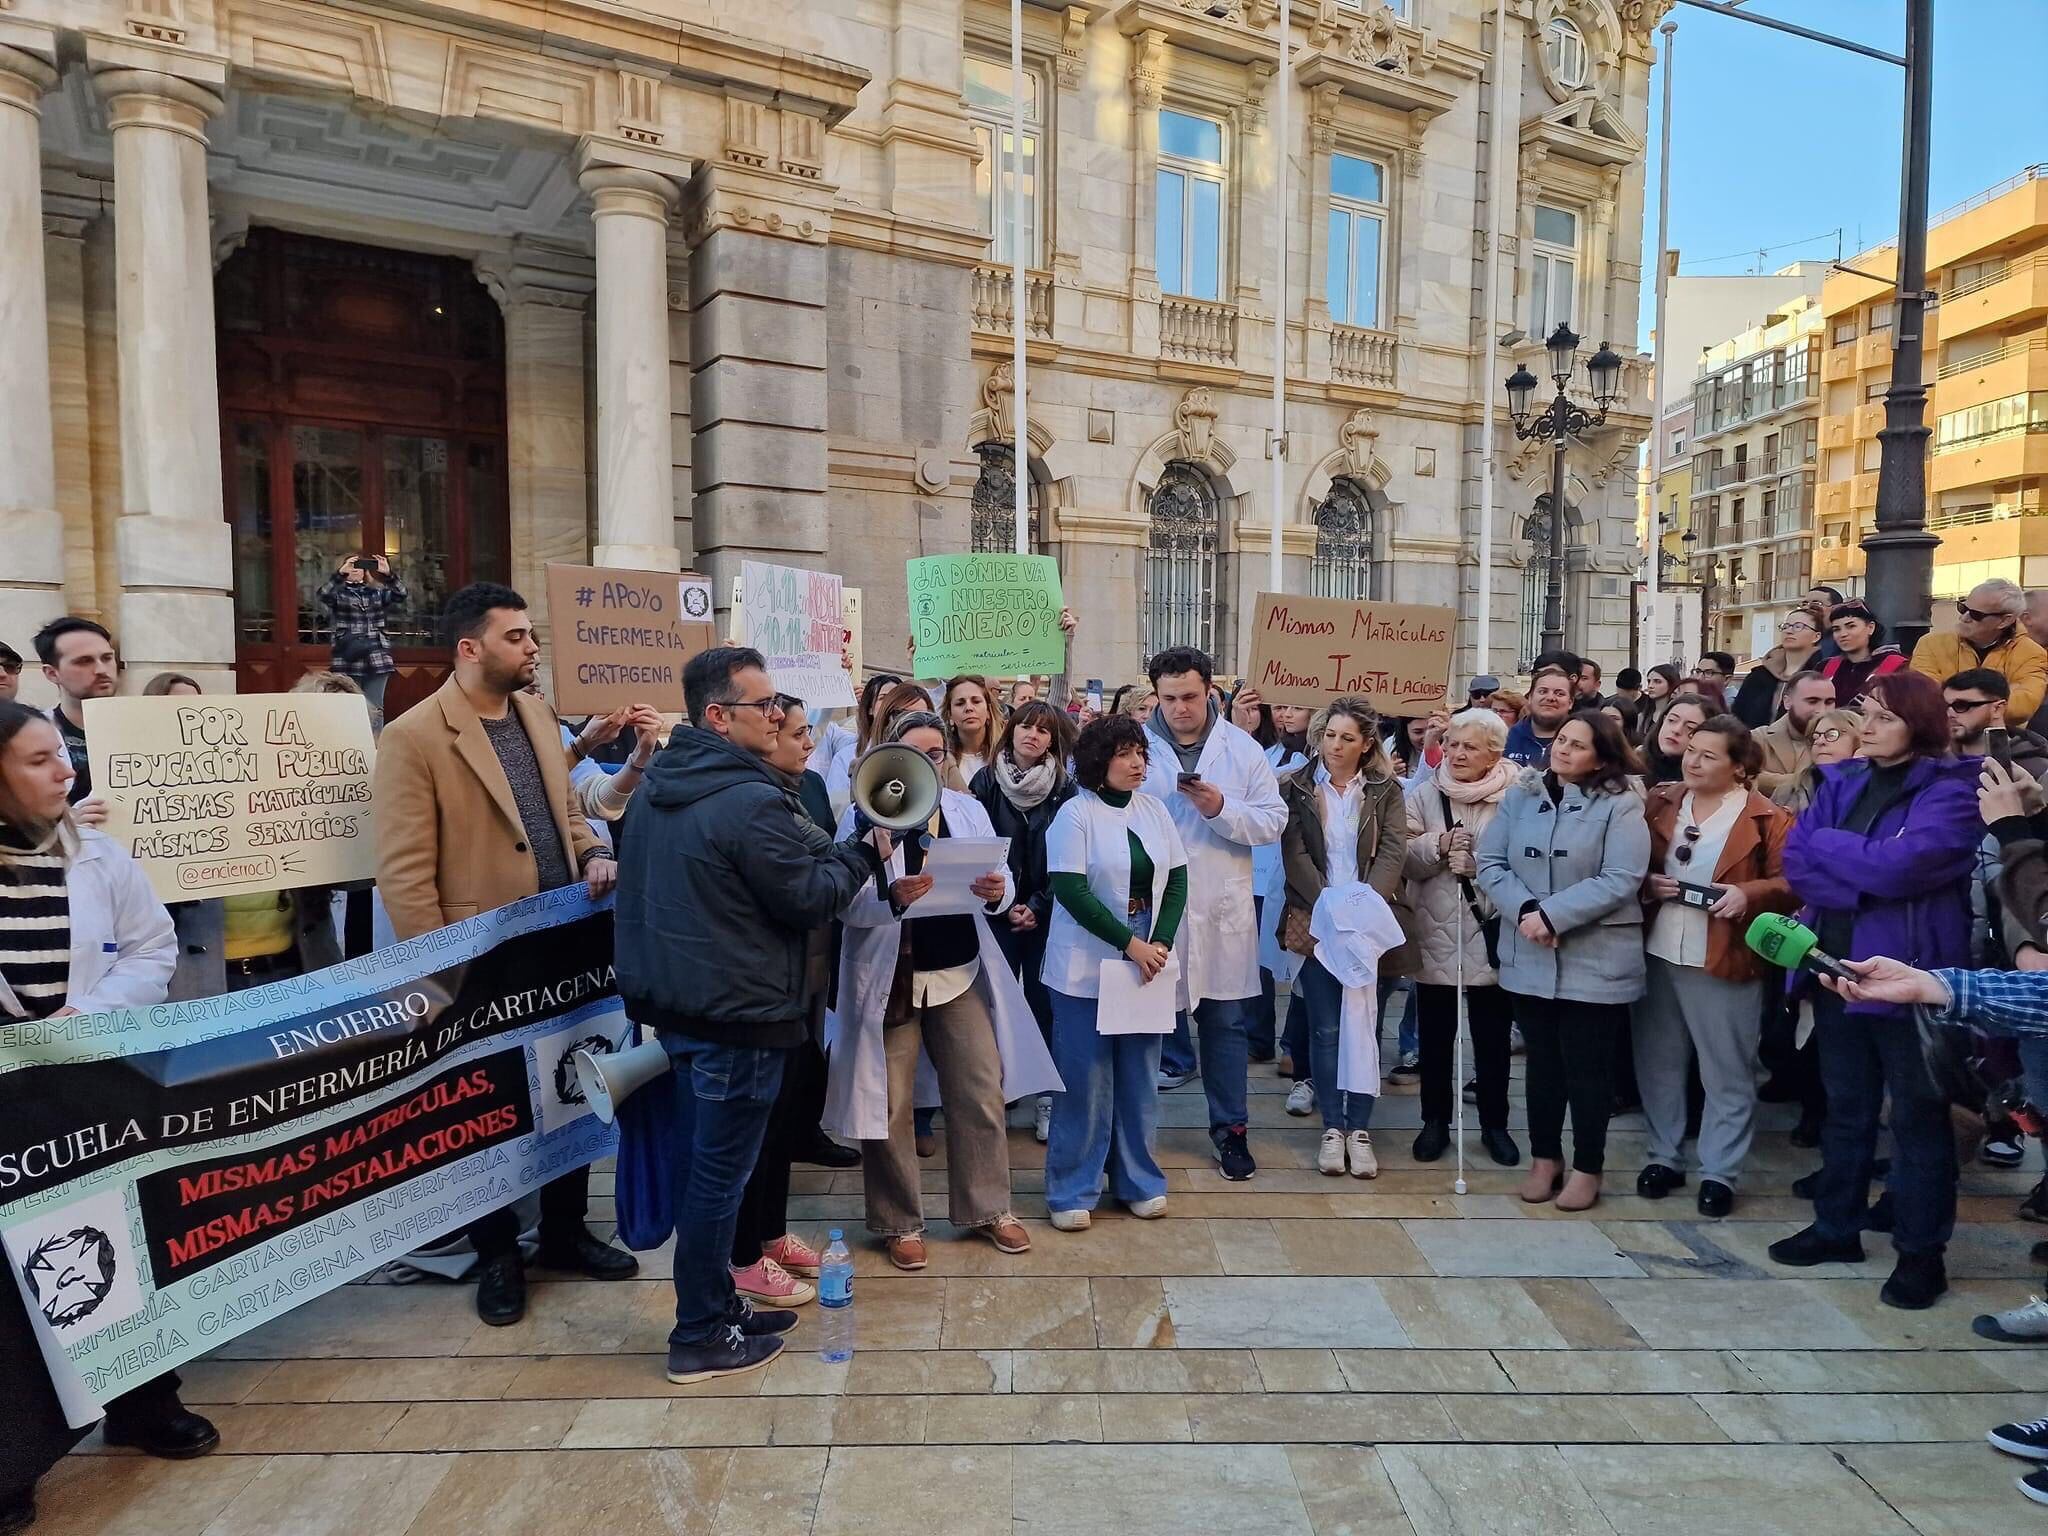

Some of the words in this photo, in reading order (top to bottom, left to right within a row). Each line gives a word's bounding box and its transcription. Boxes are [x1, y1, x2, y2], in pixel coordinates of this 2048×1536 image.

[914, 562, 947, 591] ¿A
[951, 557, 1018, 586] DÓNDE
[1023, 562, 1047, 582] VA
[602, 582, 663, 613] APOYO
[952, 588, 1049, 612] NUESTRO
[576, 620, 685, 650] ENFERMERÍA
[919, 608, 1056, 648] DINERO?
[578, 663, 673, 685] CARTAGENA
[177, 706, 248, 746] POR
[265, 709, 306, 746] LA
[109, 746, 259, 788] EDUCACIÓN
[278, 743, 369, 779] PÚBLICA
[248, 780, 372, 814] MATRÍCULAS
[132, 826, 230, 859] MISMOS
[182, 857, 273, 884] @encierroct
[149, 974, 324, 1028] CARTAGENA
[495, 882, 590, 926] CARTAGE
[267, 991, 431, 1059] ENCIERRO
[160, 1106, 215, 1139] DE
[228, 1037, 429, 1127] ENFERMERÍA
[435, 1016, 465, 1052] DE
[469, 964, 617, 1031] CARTAGENA
[178, 1143, 319, 1207] MISMAS
[324, 1069, 496, 1161] MATRICULAS,
[166, 1195, 295, 1268] MISMAS
[301, 1104, 518, 1212] INSTALACIONES
[188, 1212, 356, 1300] CARTAGENA
[363, 1147, 511, 1223] ENFERMERÍA
[198, 1244, 365, 1337] CARTAGENA
[370, 1176, 513, 1254] ENFERMERÍA
